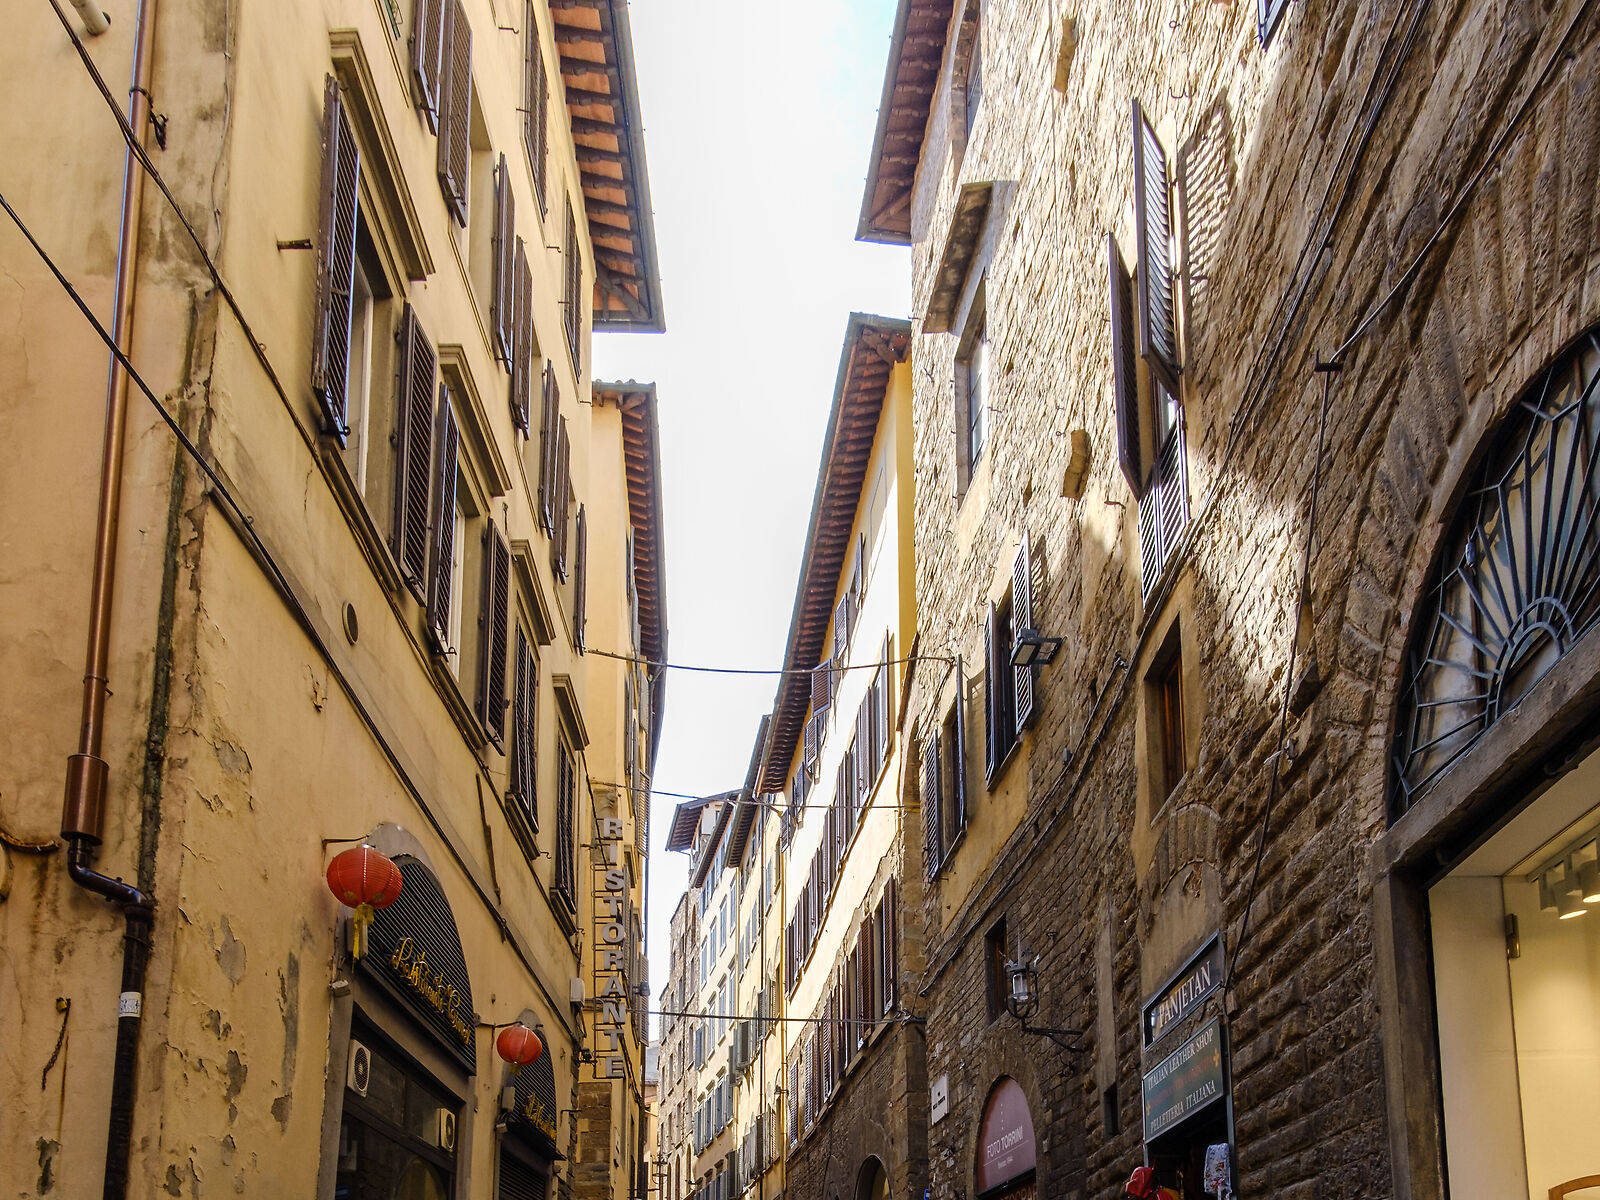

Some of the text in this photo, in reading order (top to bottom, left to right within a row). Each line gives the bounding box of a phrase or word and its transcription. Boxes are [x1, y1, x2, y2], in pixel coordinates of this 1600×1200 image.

[602, 817, 626, 1078] RISTORANTE
[1159, 962, 1211, 1028] PANJETAN
[1148, 1060, 1169, 1090] ITALIAN
[1169, 1043, 1196, 1077] LEATHER
[1196, 1027, 1214, 1056] SHOP
[1185, 1079, 1216, 1111] ITALIANA
[986, 1126, 1024, 1158] FOTO TORRINI
